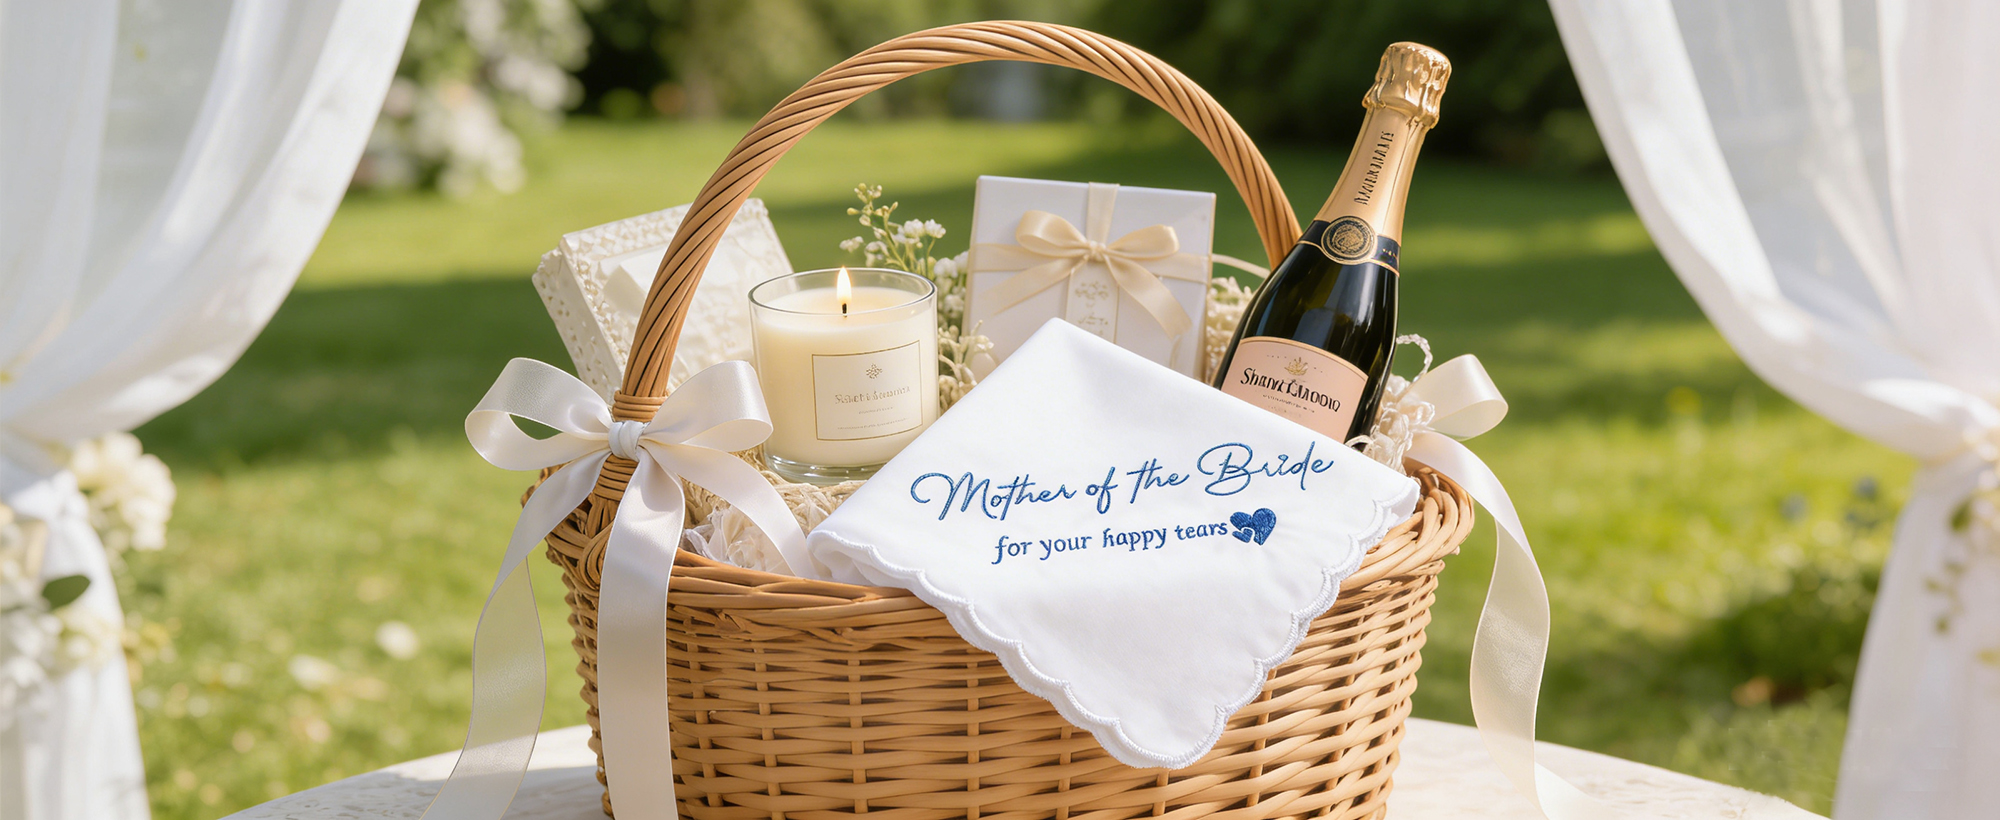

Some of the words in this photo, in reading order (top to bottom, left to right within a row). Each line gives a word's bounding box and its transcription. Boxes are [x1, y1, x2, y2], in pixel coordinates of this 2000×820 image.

[911, 472, 1078, 521] Mother
[1085, 467, 1119, 515] of
[1127, 457, 1191, 504] the
[1197, 440, 1335, 497] Bride
[991, 535, 1033, 565] for
[1039, 535, 1093, 561] your
[1102, 527, 1167, 552] happy
[1174, 522, 1228, 541] tears
